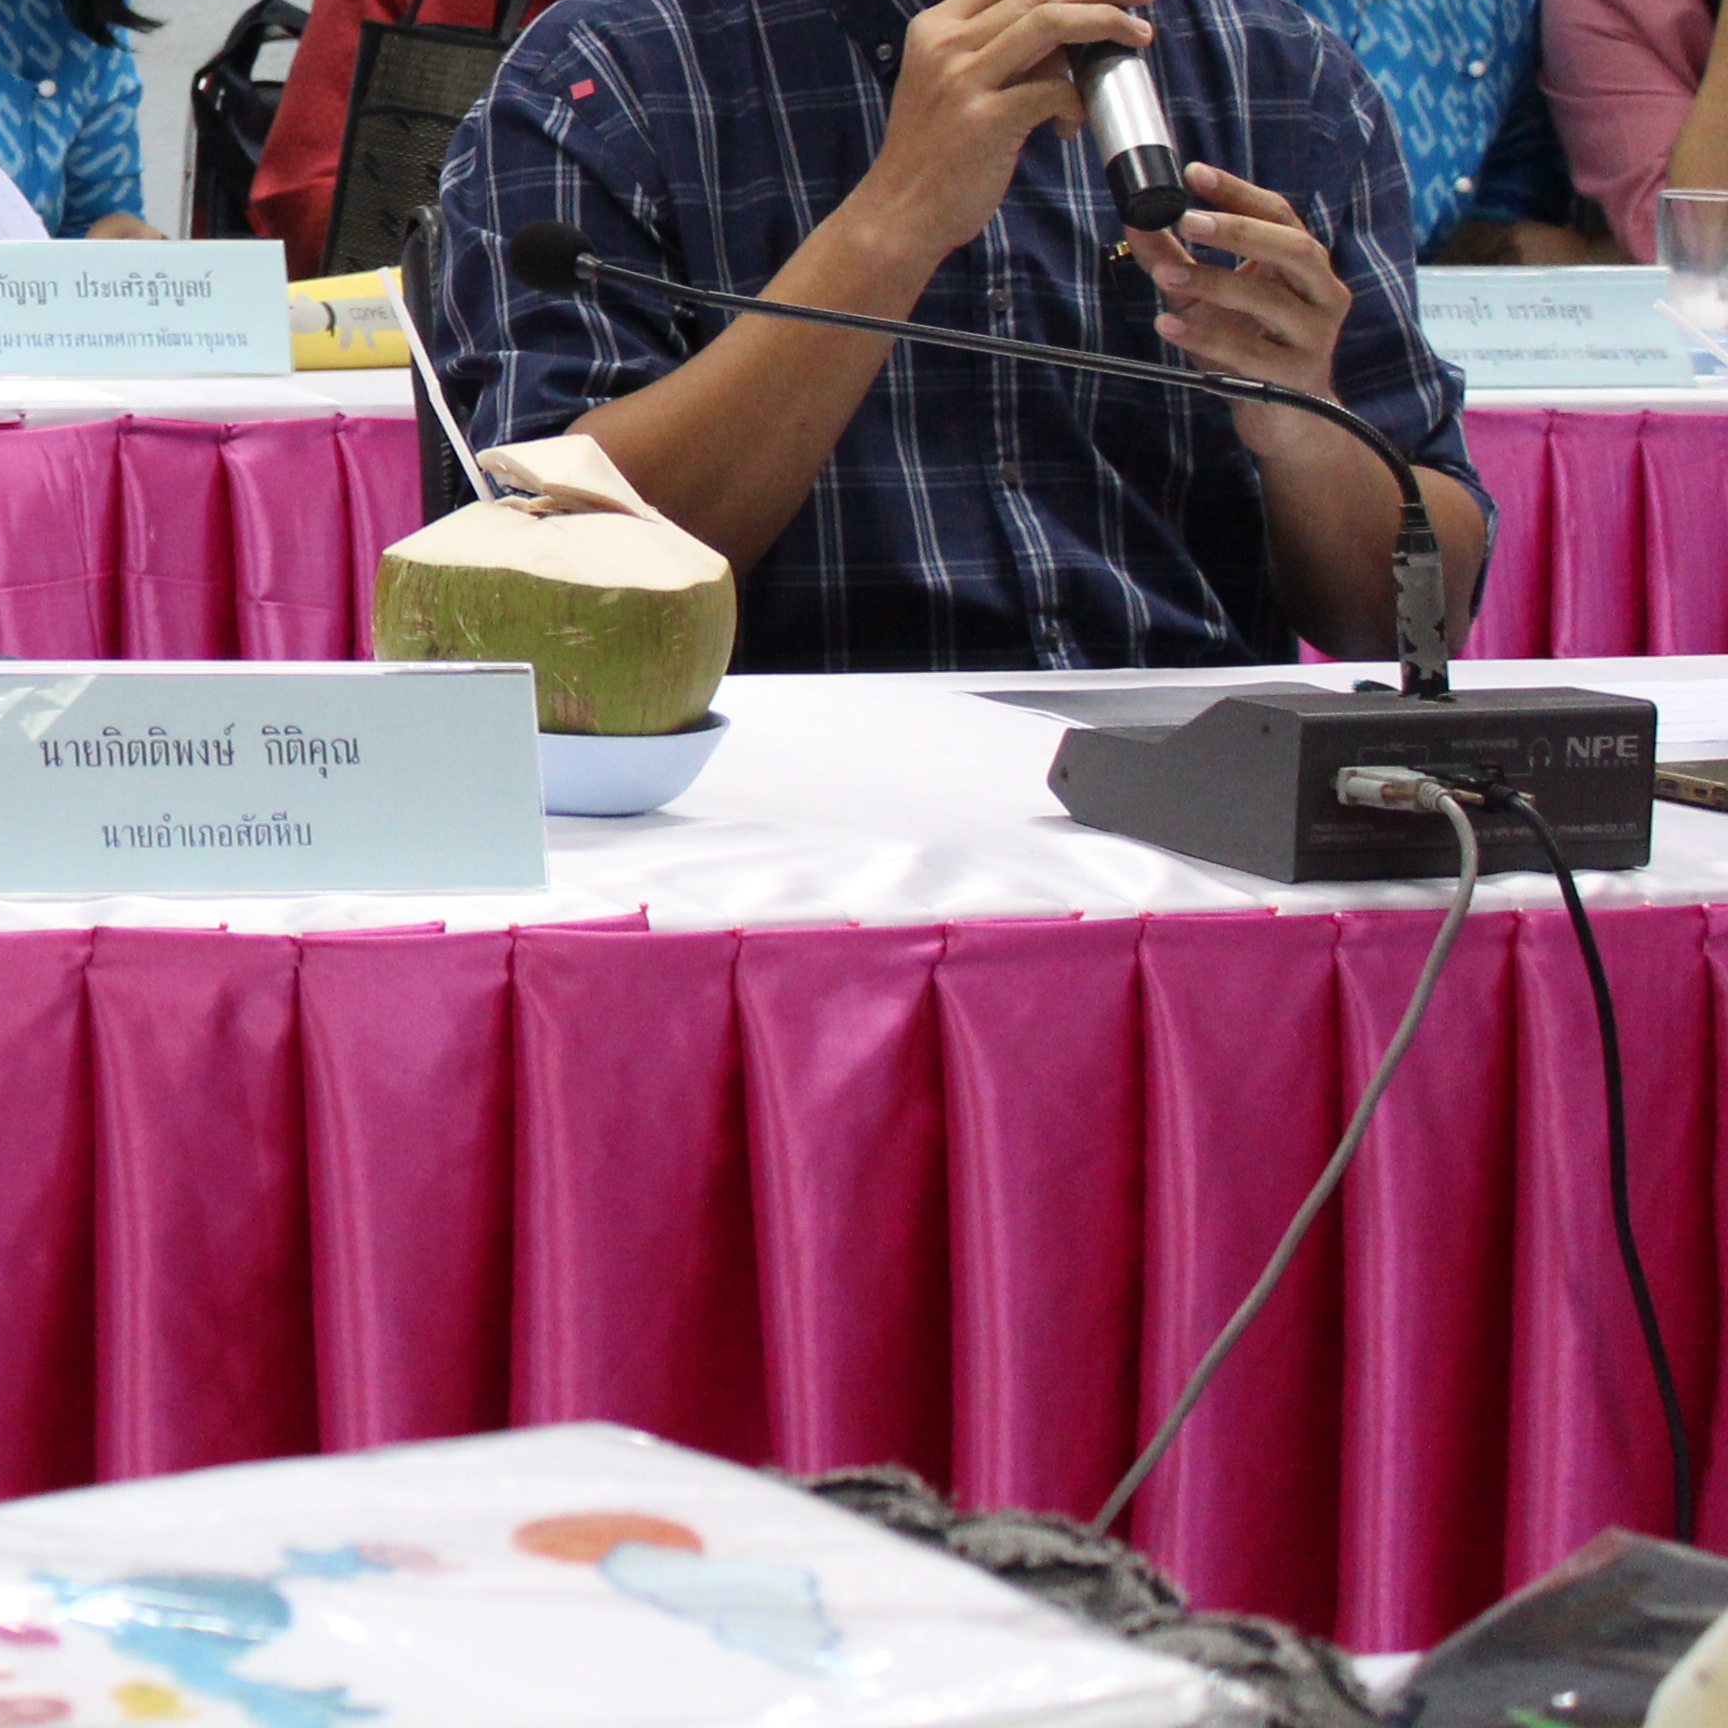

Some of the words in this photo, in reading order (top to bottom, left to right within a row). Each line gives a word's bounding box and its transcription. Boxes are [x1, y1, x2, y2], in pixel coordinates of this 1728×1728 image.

[74, 270, 213, 308] ประเสริฐวิบูลย์
[39, 722, 237, 768] นายกิตติพงษ์
[260, 724, 362, 779] กิติคุณ
[1566, 734, 1640, 759] NPE
[101, 810, 314, 849] นายอำเภอสัตหีบ
